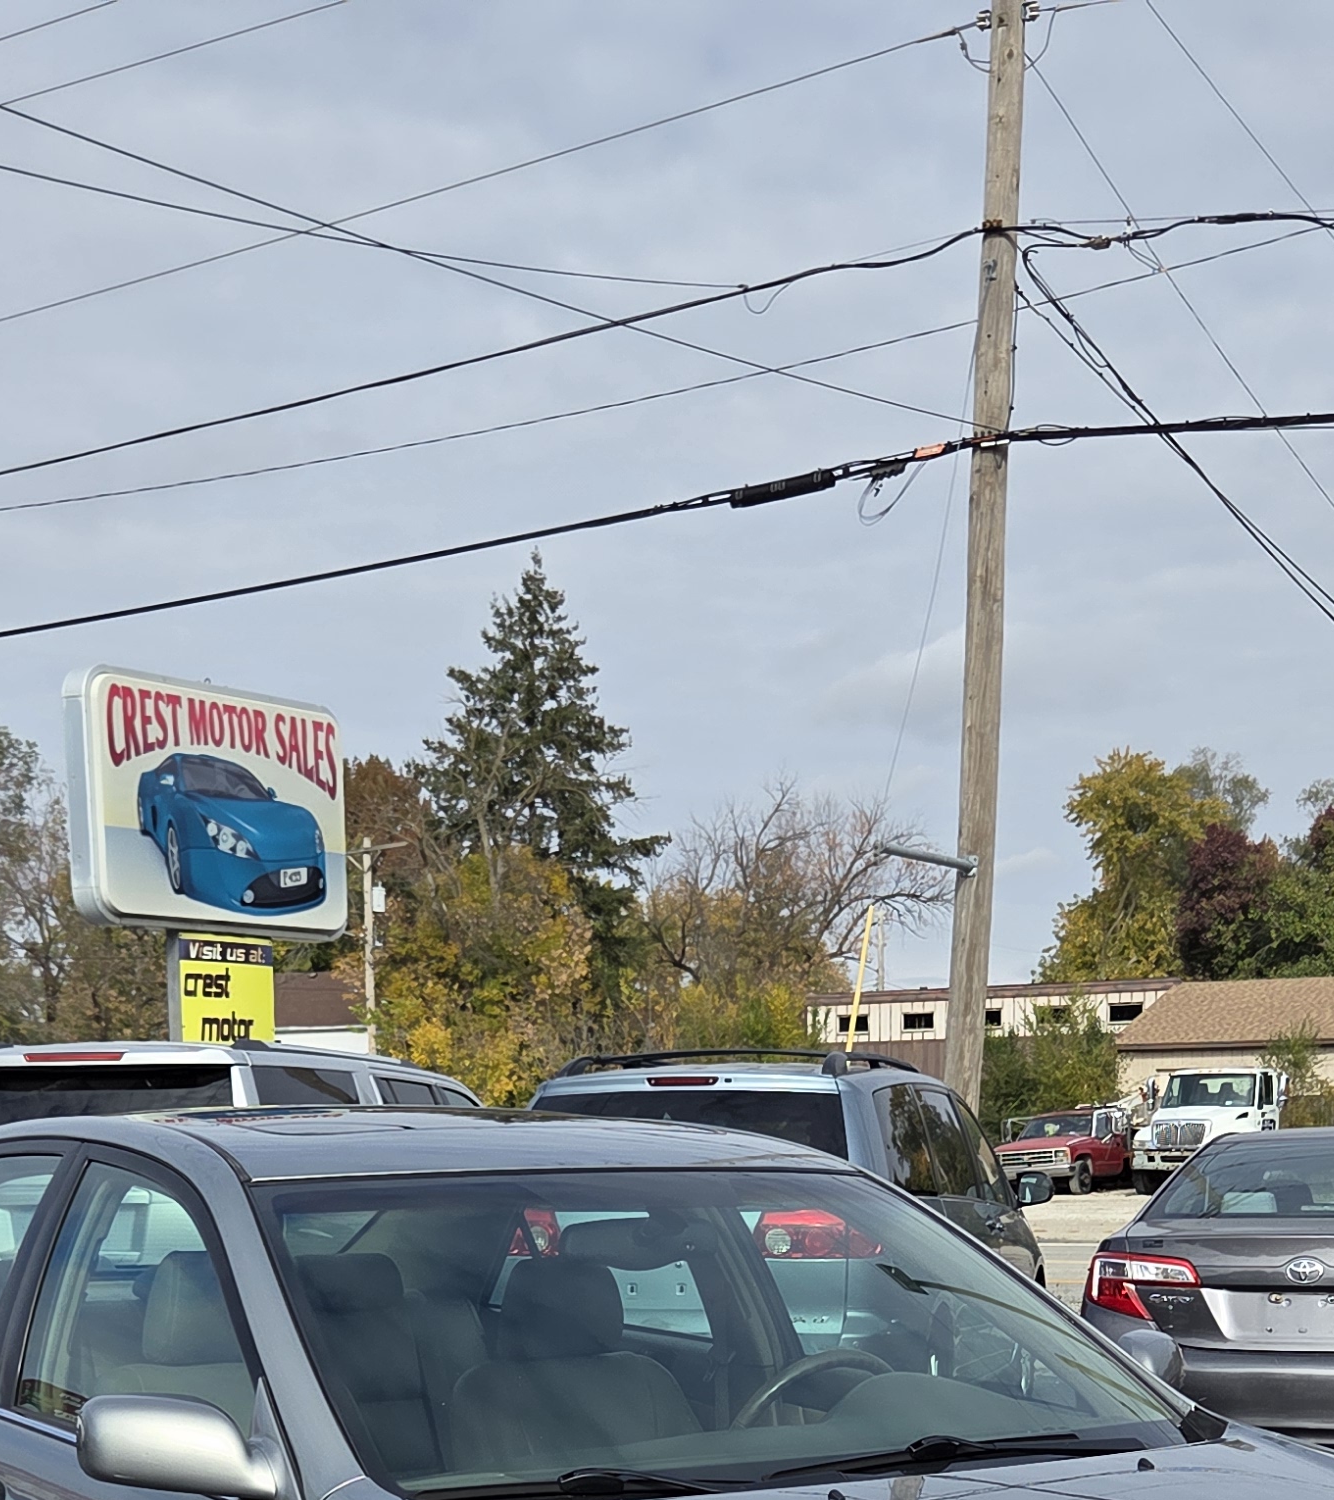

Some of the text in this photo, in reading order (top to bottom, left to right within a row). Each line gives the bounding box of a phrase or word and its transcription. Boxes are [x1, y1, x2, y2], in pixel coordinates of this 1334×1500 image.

[106, 683, 336, 800] CREST MOTOR SALES
[189, 942, 266, 963] Visit us at:
[184, 967, 231, 998] crest
[201, 1011, 254, 1041] motor
